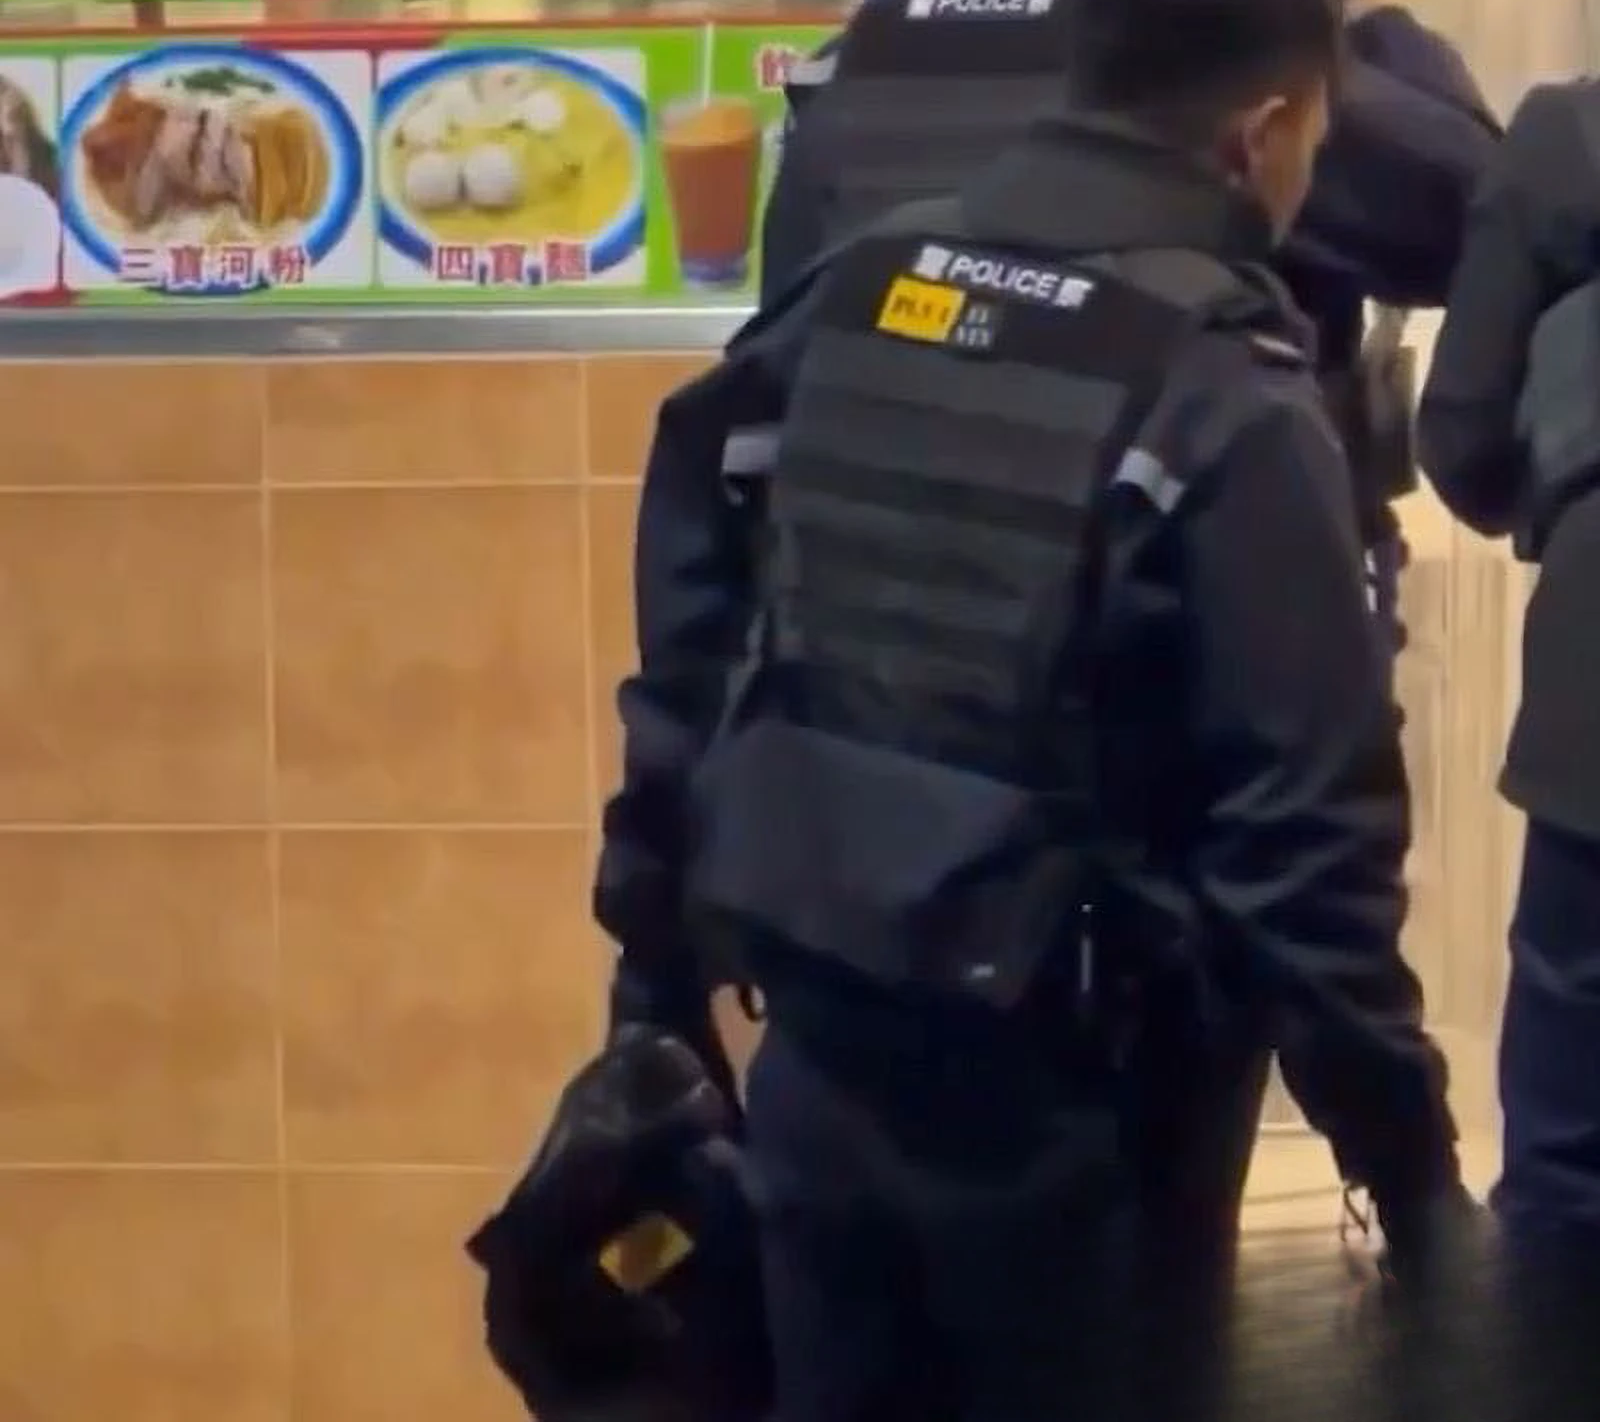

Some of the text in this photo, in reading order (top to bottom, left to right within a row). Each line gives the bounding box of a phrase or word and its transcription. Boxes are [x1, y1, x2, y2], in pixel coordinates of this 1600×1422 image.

[120, 245, 307, 284] 三寶河粉
[434, 242, 590, 282] 四寶麵
